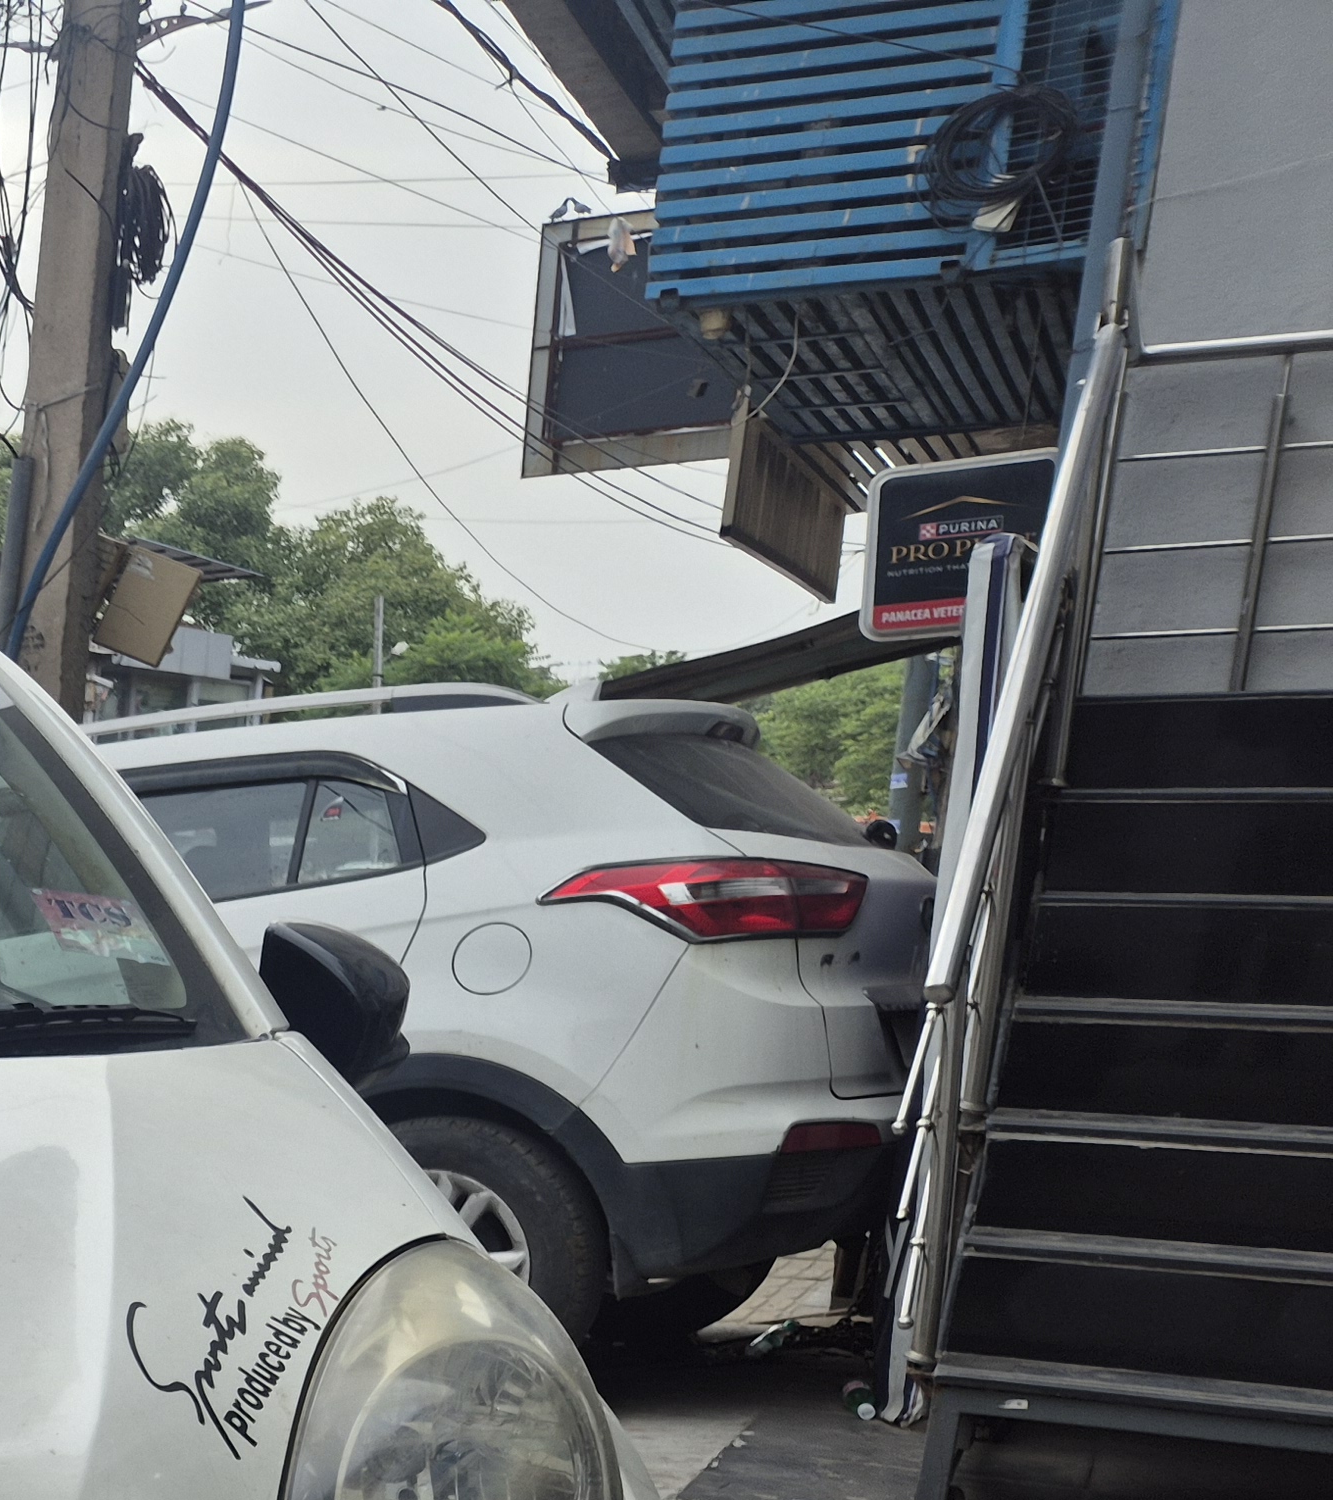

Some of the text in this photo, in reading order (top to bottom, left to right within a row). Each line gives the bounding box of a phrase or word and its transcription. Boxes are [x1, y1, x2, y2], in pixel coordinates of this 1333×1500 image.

[938, 518, 998, 535] PURINA
[889, 541, 949, 564] PRO
[887, 562, 970, 578] NUTRITION THA
[881, 608, 932, 624] PANACEA
[46, 897, 132, 928] TCS
